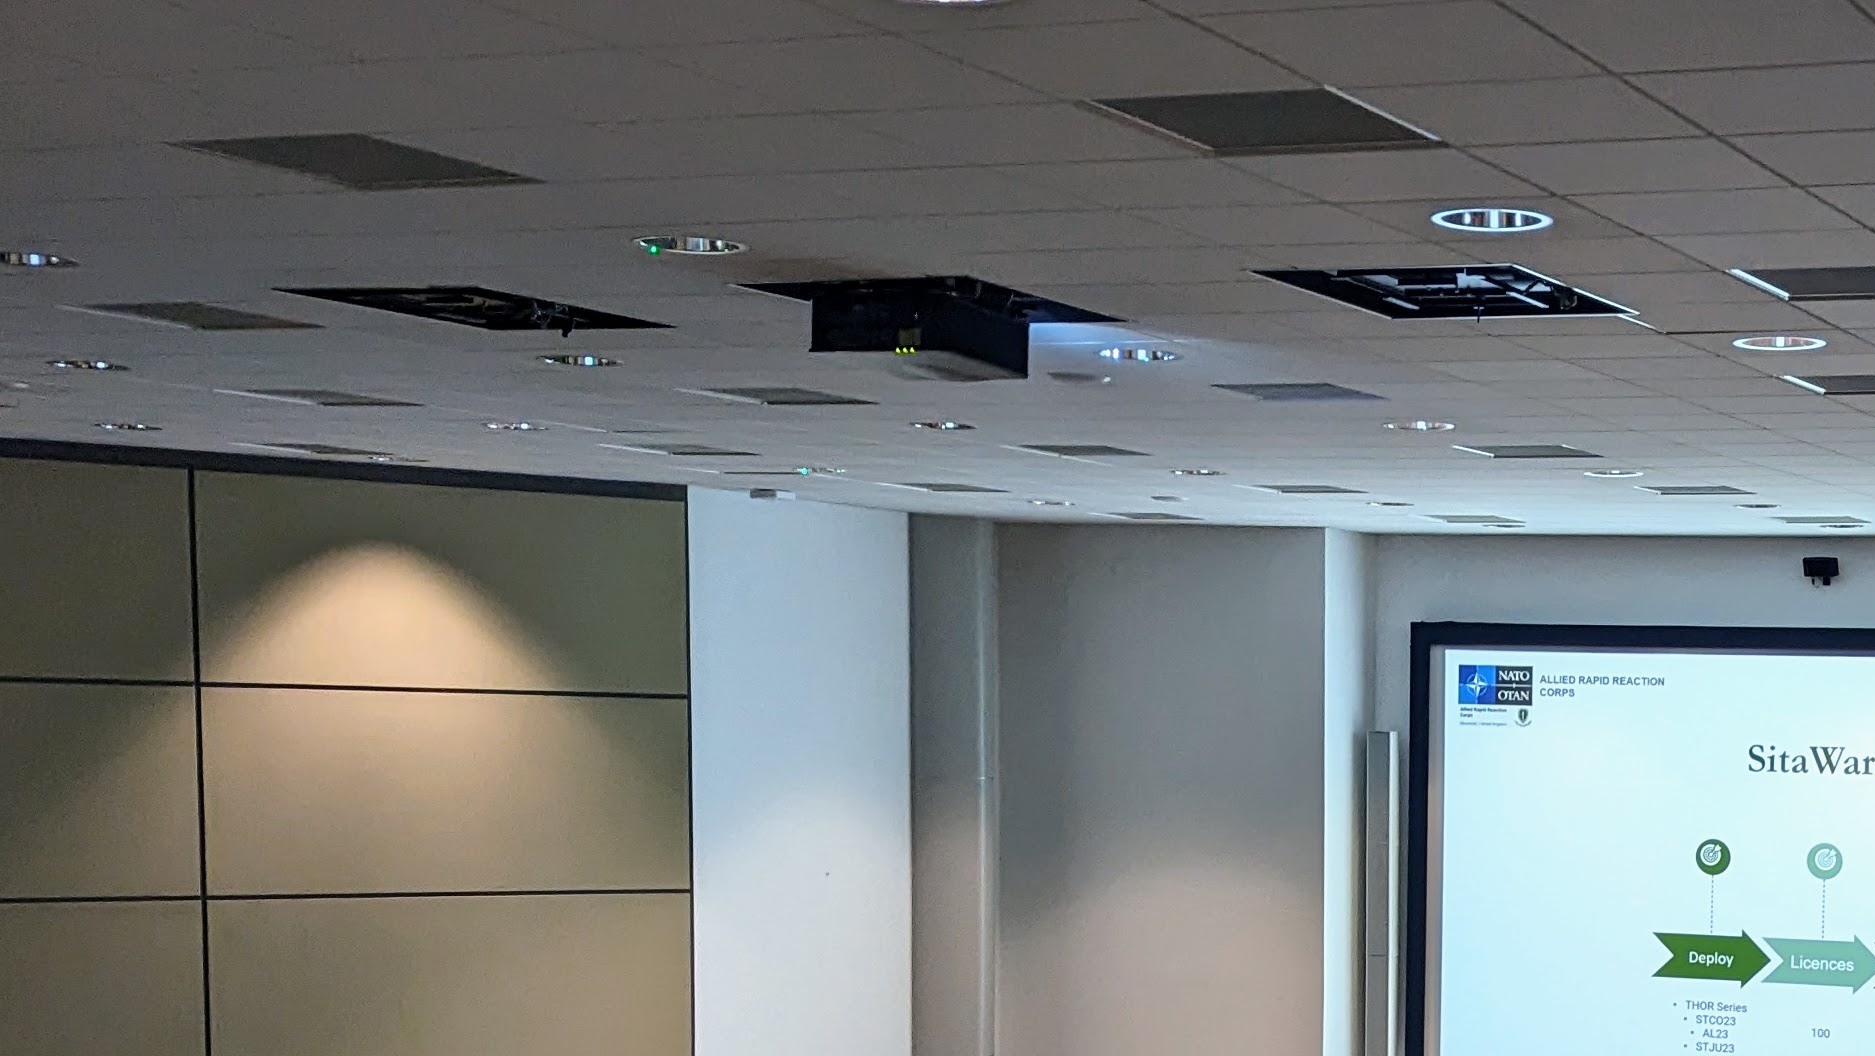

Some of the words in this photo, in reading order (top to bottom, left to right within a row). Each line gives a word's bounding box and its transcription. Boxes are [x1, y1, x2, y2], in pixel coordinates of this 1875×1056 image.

[1498, 669, 1530, 681] NATO
[1540, 674, 1576, 685] ALLIED
[1578, 675, 1610, 686] RAPID
[1612, 676, 1665, 687] REACTION
[1497, 689, 1530, 702] OTAN
[1539, 687, 1575, 698] CORPS
[1688, 950, 1735, 969] Deploy
[1790, 955, 1855, 973] Licences
[1685, 1000, 1715, 1011] THOR
[1716, 1002, 1748, 1013] Series
[1695, 1014, 1737, 1026] STCO23
[1702, 1028, 1729, 1039] AL23
[1811, 1028, 1831, 1039] 100
[1695, 1041, 1736, 1053] STJU23
